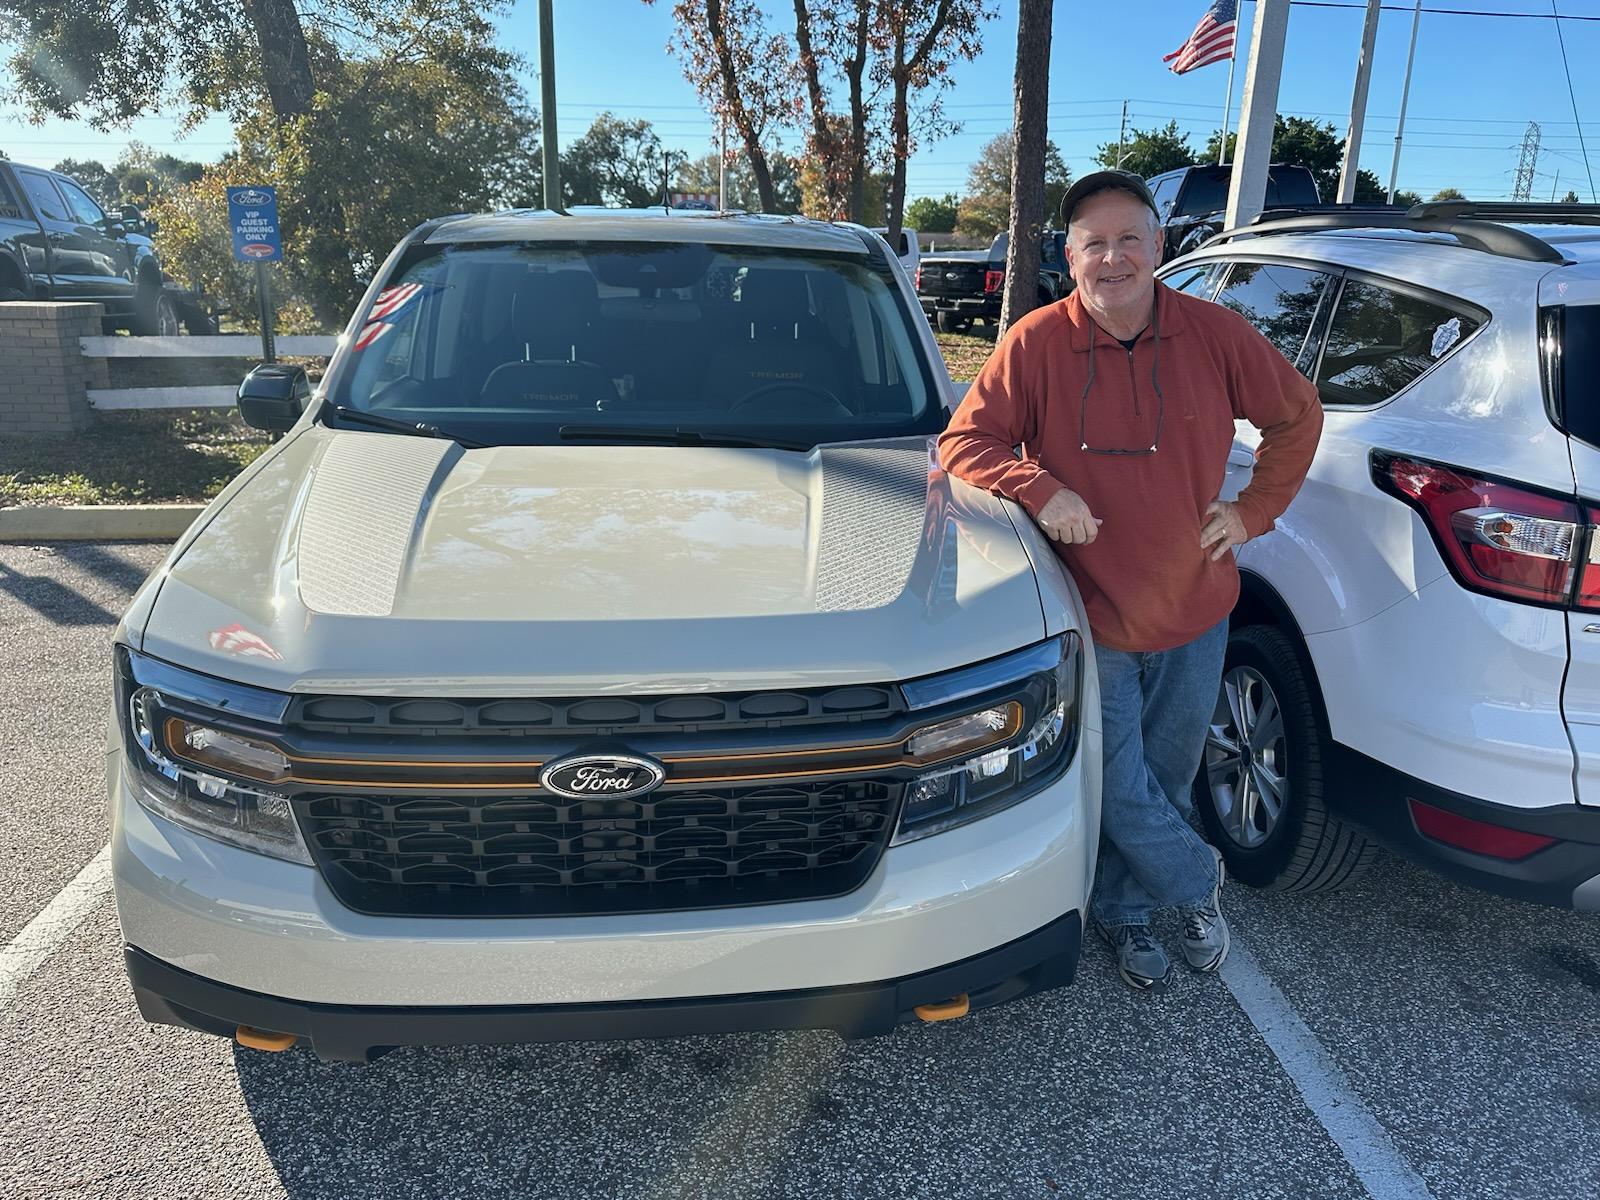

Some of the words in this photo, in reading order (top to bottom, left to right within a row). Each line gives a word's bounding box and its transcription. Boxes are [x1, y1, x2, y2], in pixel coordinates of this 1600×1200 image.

[239, 192, 263, 204] Ford
[750, 371, 803, 380] TREMOR
[521, 392, 578, 401] TREMOR
[570, 767, 634, 791] Ford
